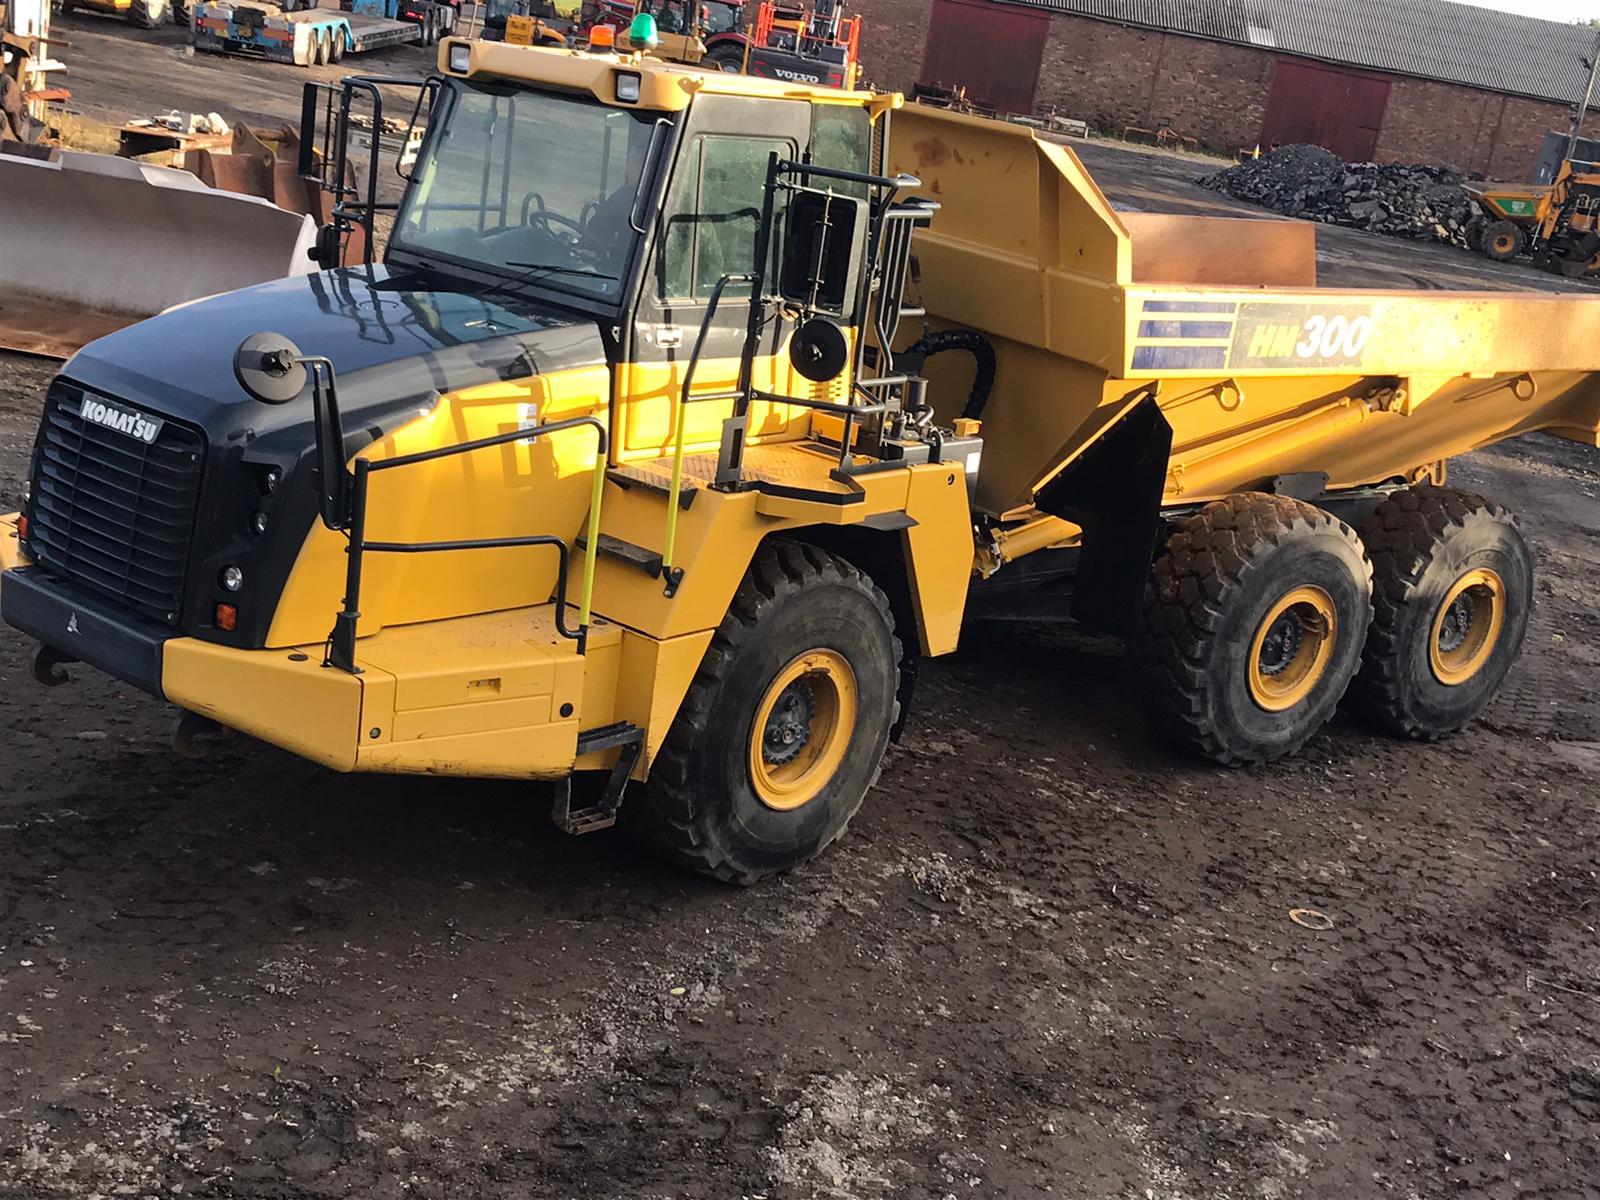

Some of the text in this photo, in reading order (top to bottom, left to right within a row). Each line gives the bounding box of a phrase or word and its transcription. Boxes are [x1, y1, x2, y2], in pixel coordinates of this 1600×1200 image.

[774, 68, 819, 84] VOLVO
[1247, 314, 1370, 358] HM300
[81, 399, 157, 442] KOMATSU
